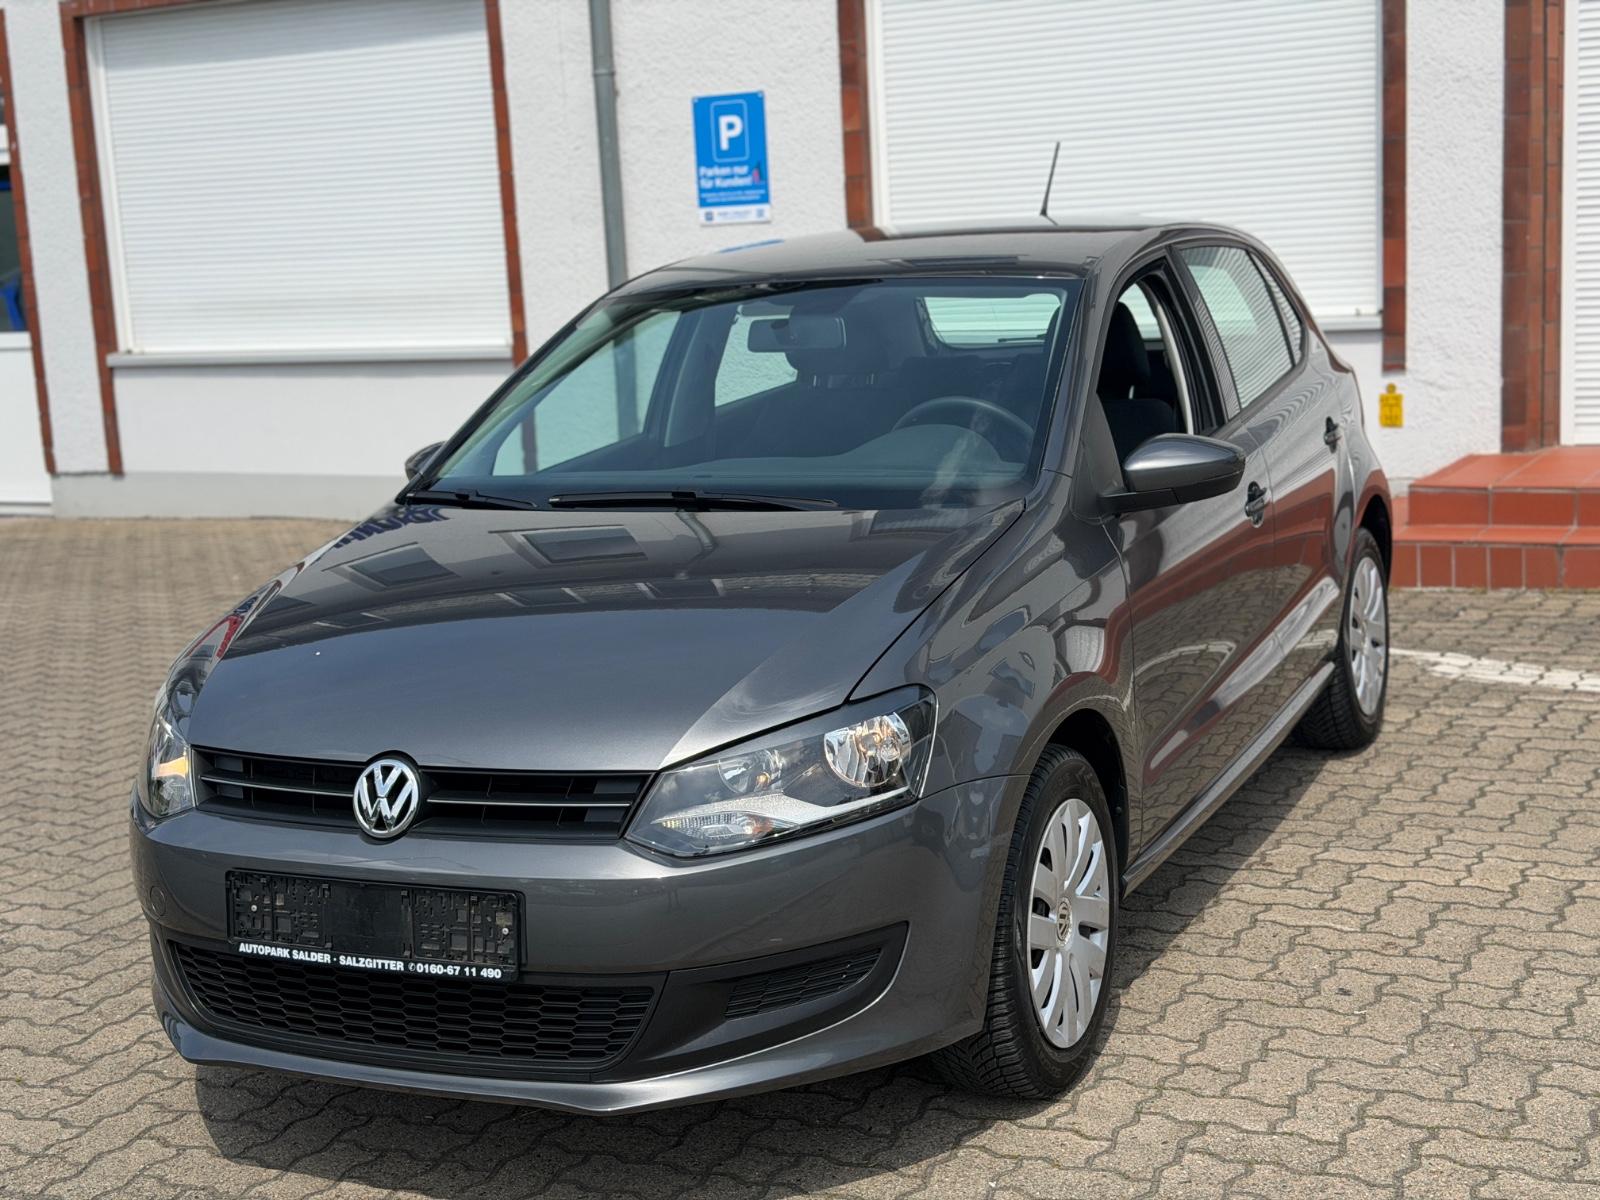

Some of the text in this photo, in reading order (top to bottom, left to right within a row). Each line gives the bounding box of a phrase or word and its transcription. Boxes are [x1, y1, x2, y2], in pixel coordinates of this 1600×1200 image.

[718, 114, 743, 151] P
[699, 165, 749, 178] Parken nur
[356, 760, 416, 834] VW
[238, 942, 502, 979] AUTOPARK SALDER SALZGITTER 0160-67 11 490
